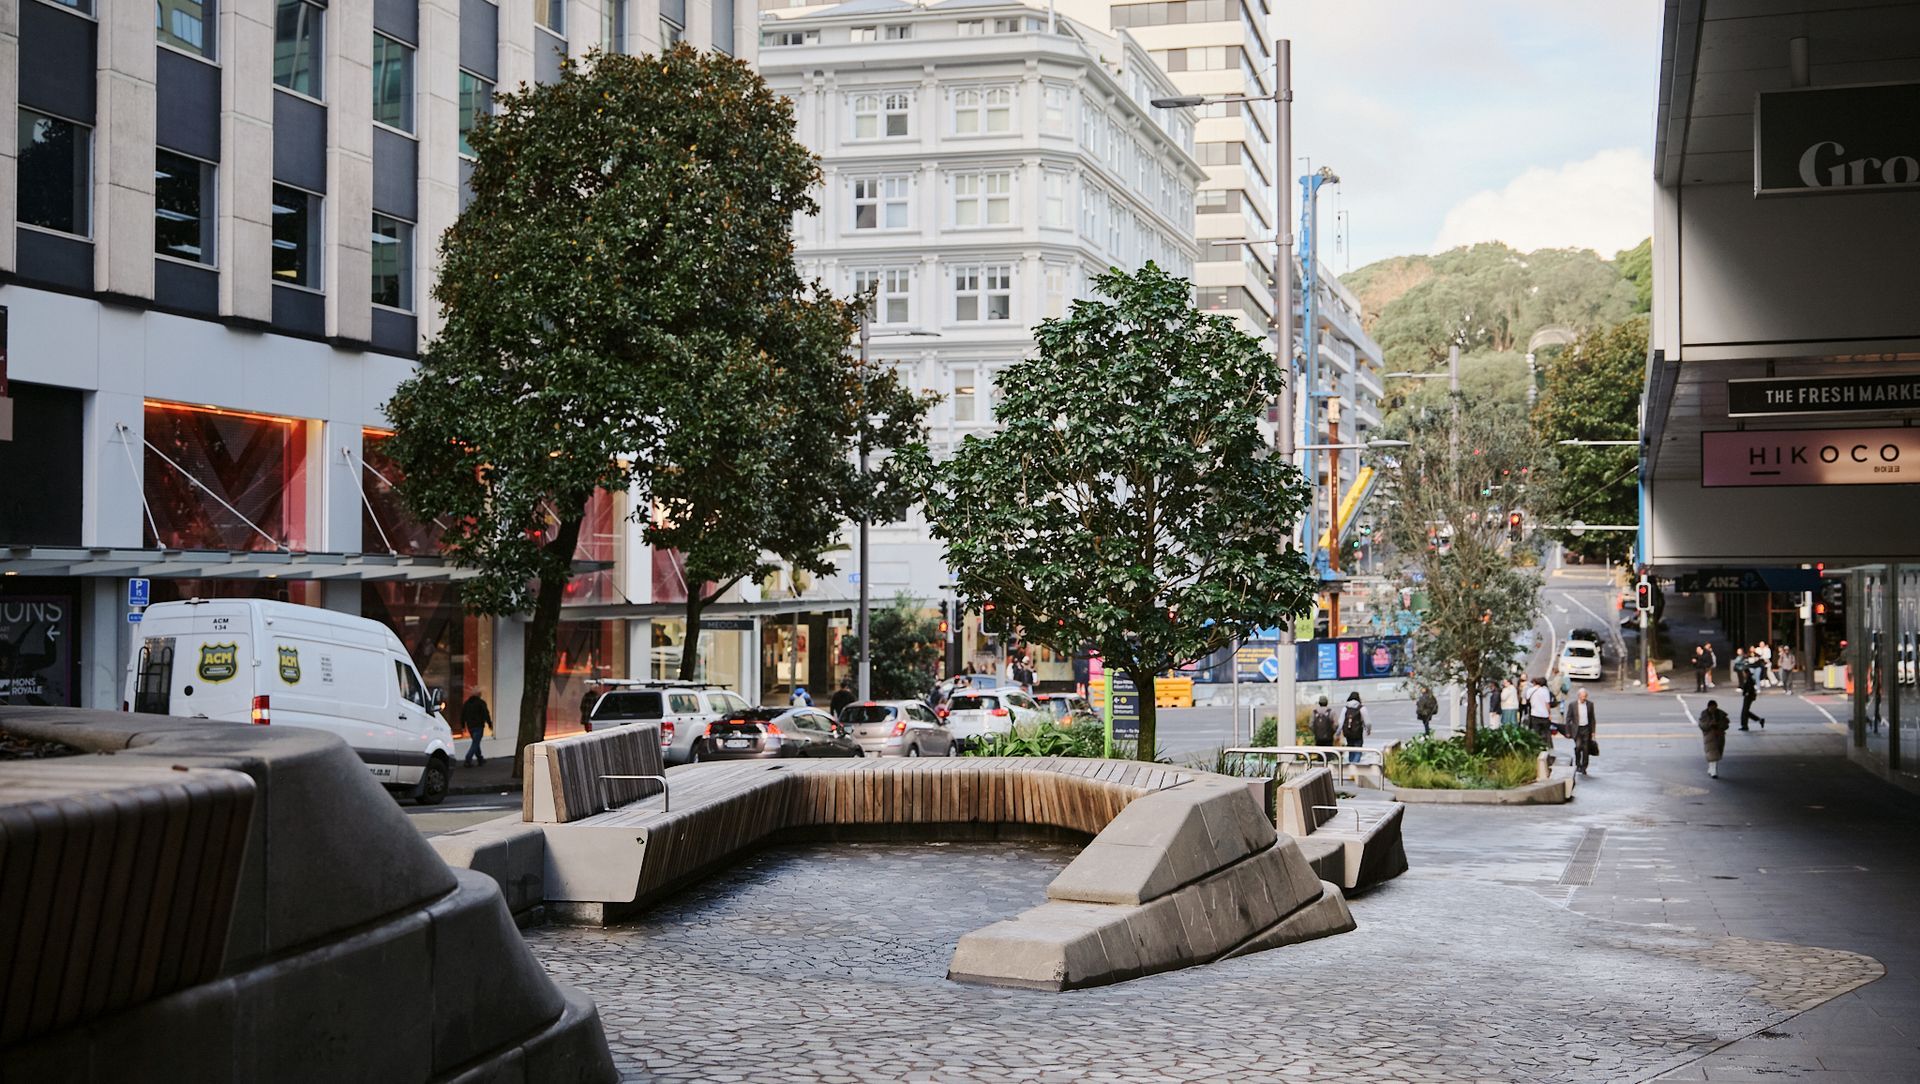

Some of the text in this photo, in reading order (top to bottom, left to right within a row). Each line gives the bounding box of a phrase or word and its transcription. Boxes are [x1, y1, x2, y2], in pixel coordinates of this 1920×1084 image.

[1766, 389, 1793, 403] THE
[1799, 386, 1854, 404] FRESH
[1749, 444, 1900, 465] HIKOCO
[135, 580, 143, 589] P
[1706, 576, 1739, 588] ANZ
[204, 652, 233, 664] ACM
[281, 655, 298, 667] ACM
[11, 678, 36, 687] MONS
[11, 686, 43, 695] ROYALE
